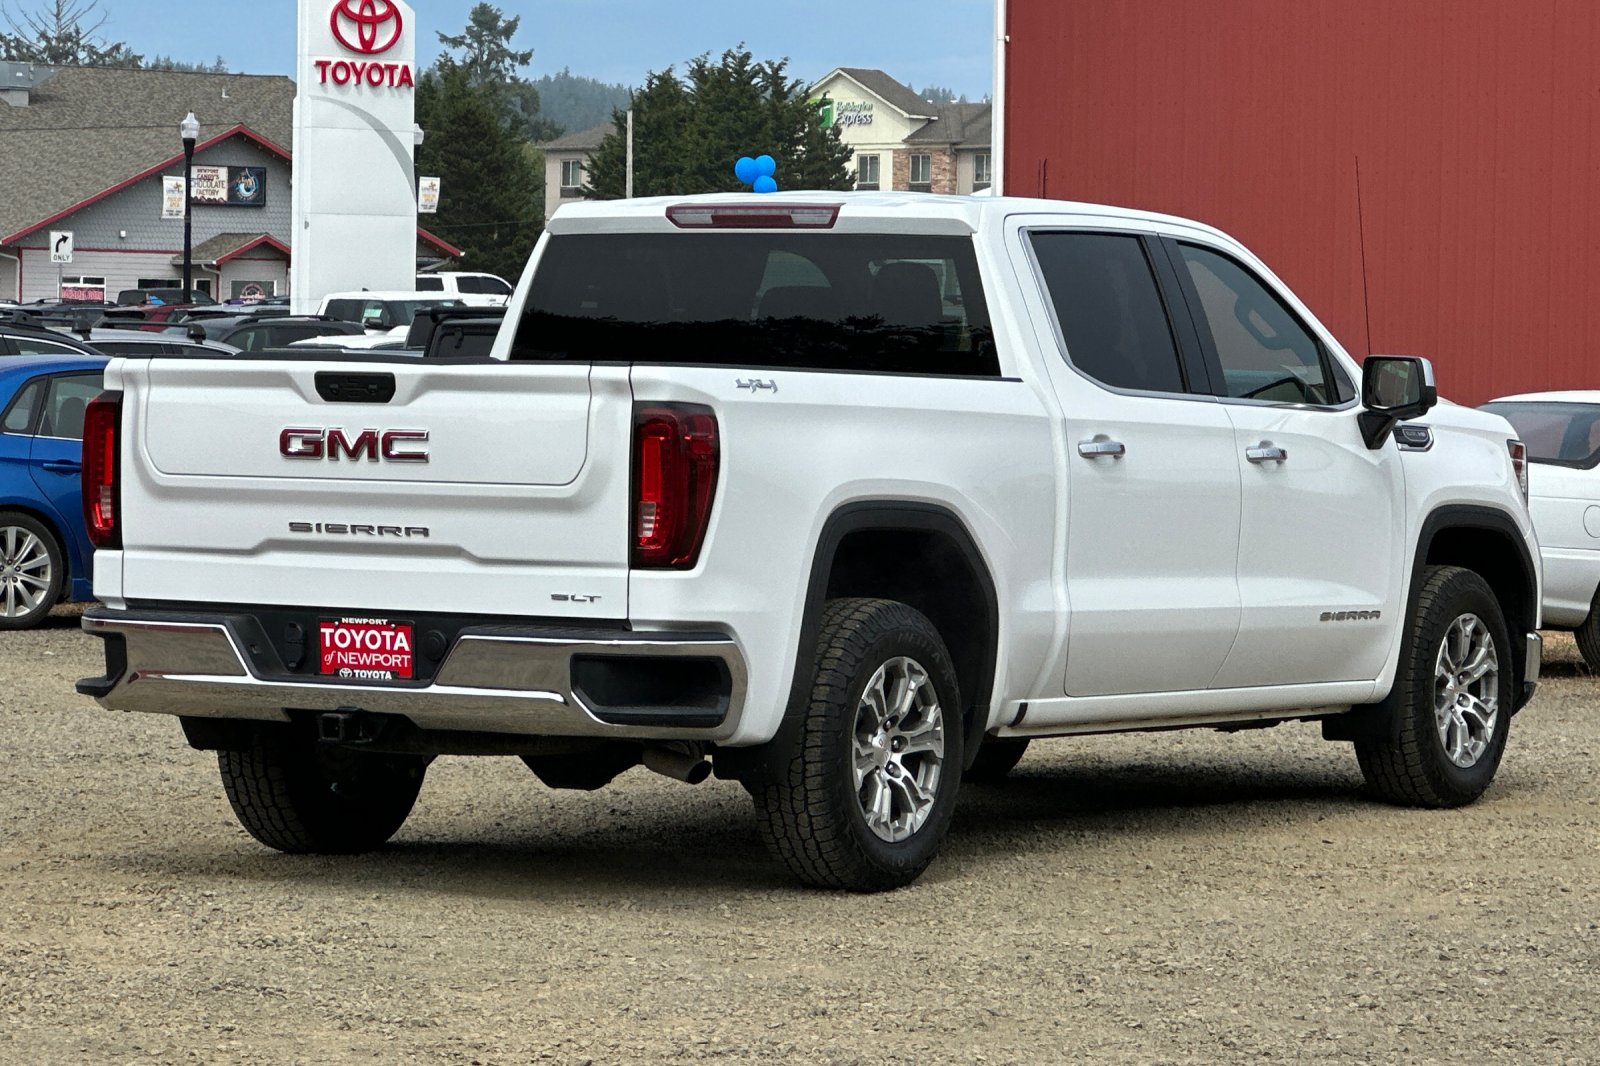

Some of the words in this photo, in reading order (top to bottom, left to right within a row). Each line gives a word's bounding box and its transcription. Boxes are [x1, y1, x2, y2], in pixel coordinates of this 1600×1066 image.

[314, 60, 414, 88] TOYOTA
[837, 112, 873, 127] Express
[191, 180, 226, 189] CHOCOLATE
[196, 188, 219, 196] FACTORY
[279, 427, 429, 463] GMC
[289, 522, 430, 537] SIERRA
[551, 594, 602, 602] SLT
[341, 617, 388, 625] NEWPORT
[1320, 610, 1381, 621] SIERRA
[320, 627, 410, 651] TOYOTA
[324, 650, 336, 665] of
[337, 651, 411, 668] NEWPORT
[353, 669, 393, 680] TOYOTA
